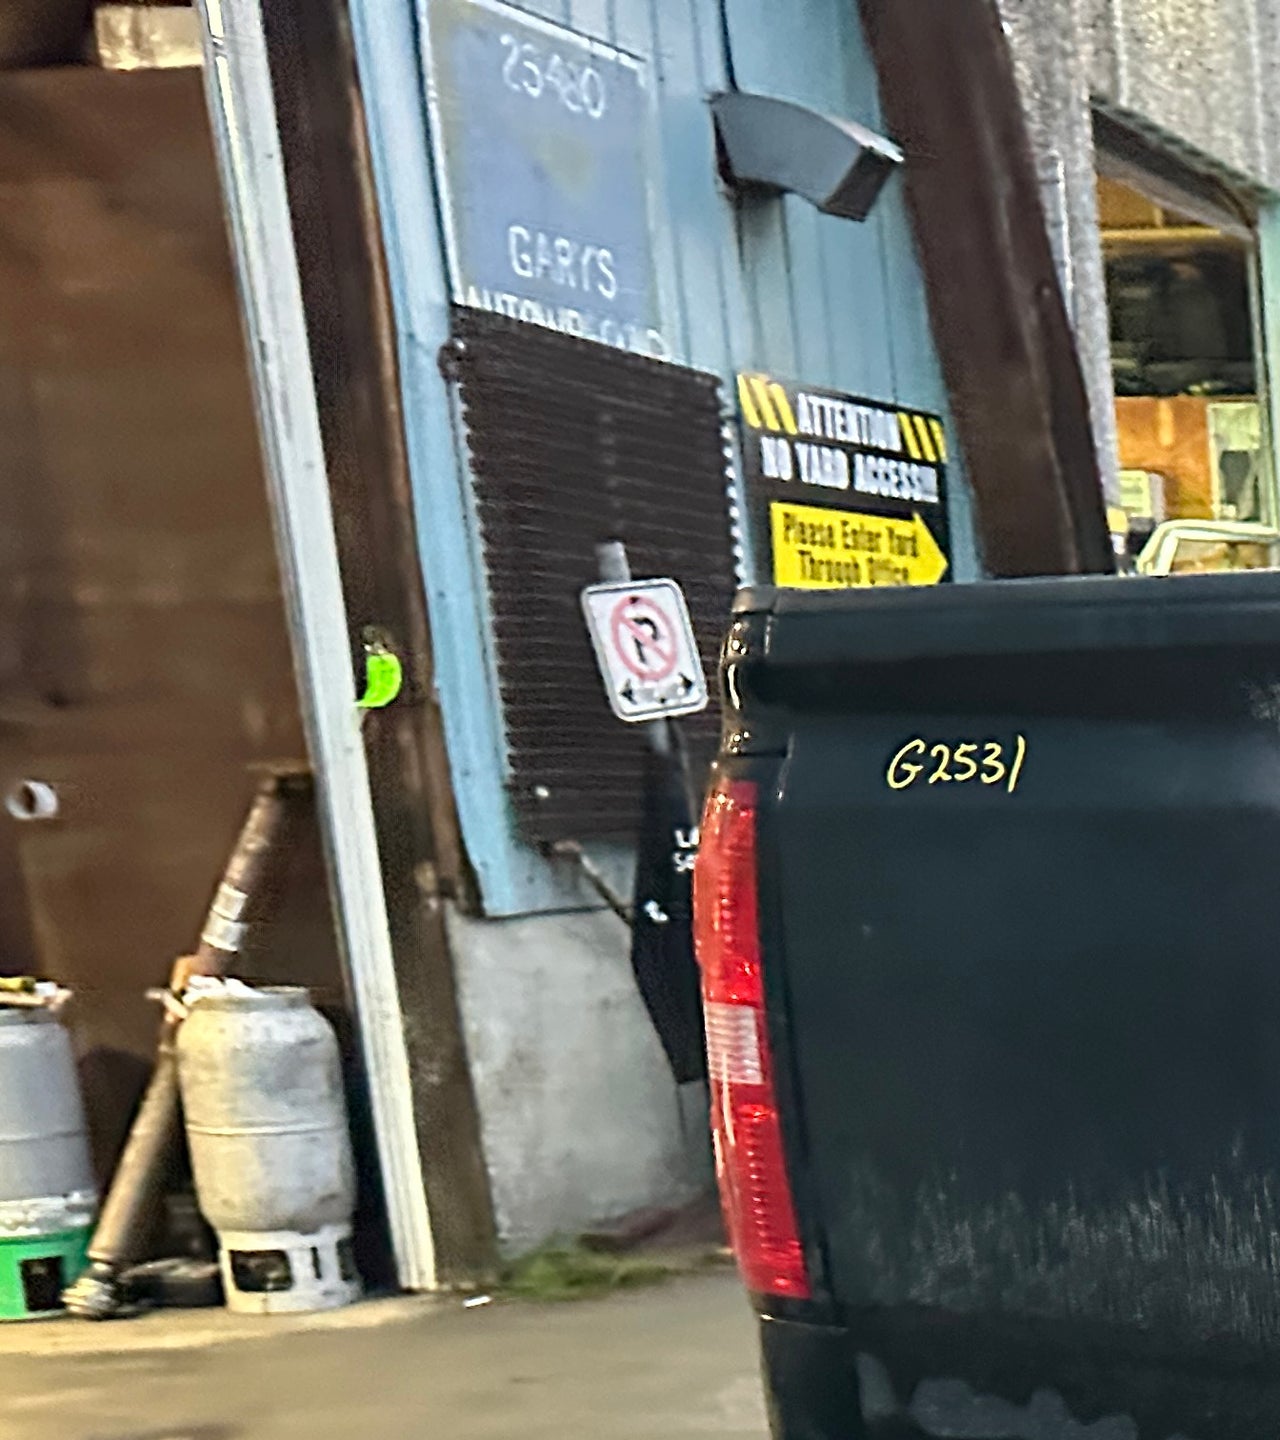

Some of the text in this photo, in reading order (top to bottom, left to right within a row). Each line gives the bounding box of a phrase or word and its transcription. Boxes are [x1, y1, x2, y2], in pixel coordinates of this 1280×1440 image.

[797, 392, 902, 452] ATTENTION
[761, 436, 793, 482] NO
[795, 442, 849, 490] YARD
[783, 511, 836, 549] Please
[841, 519, 881, 553] Enter
[886, 734, 1027, 793] G2531
